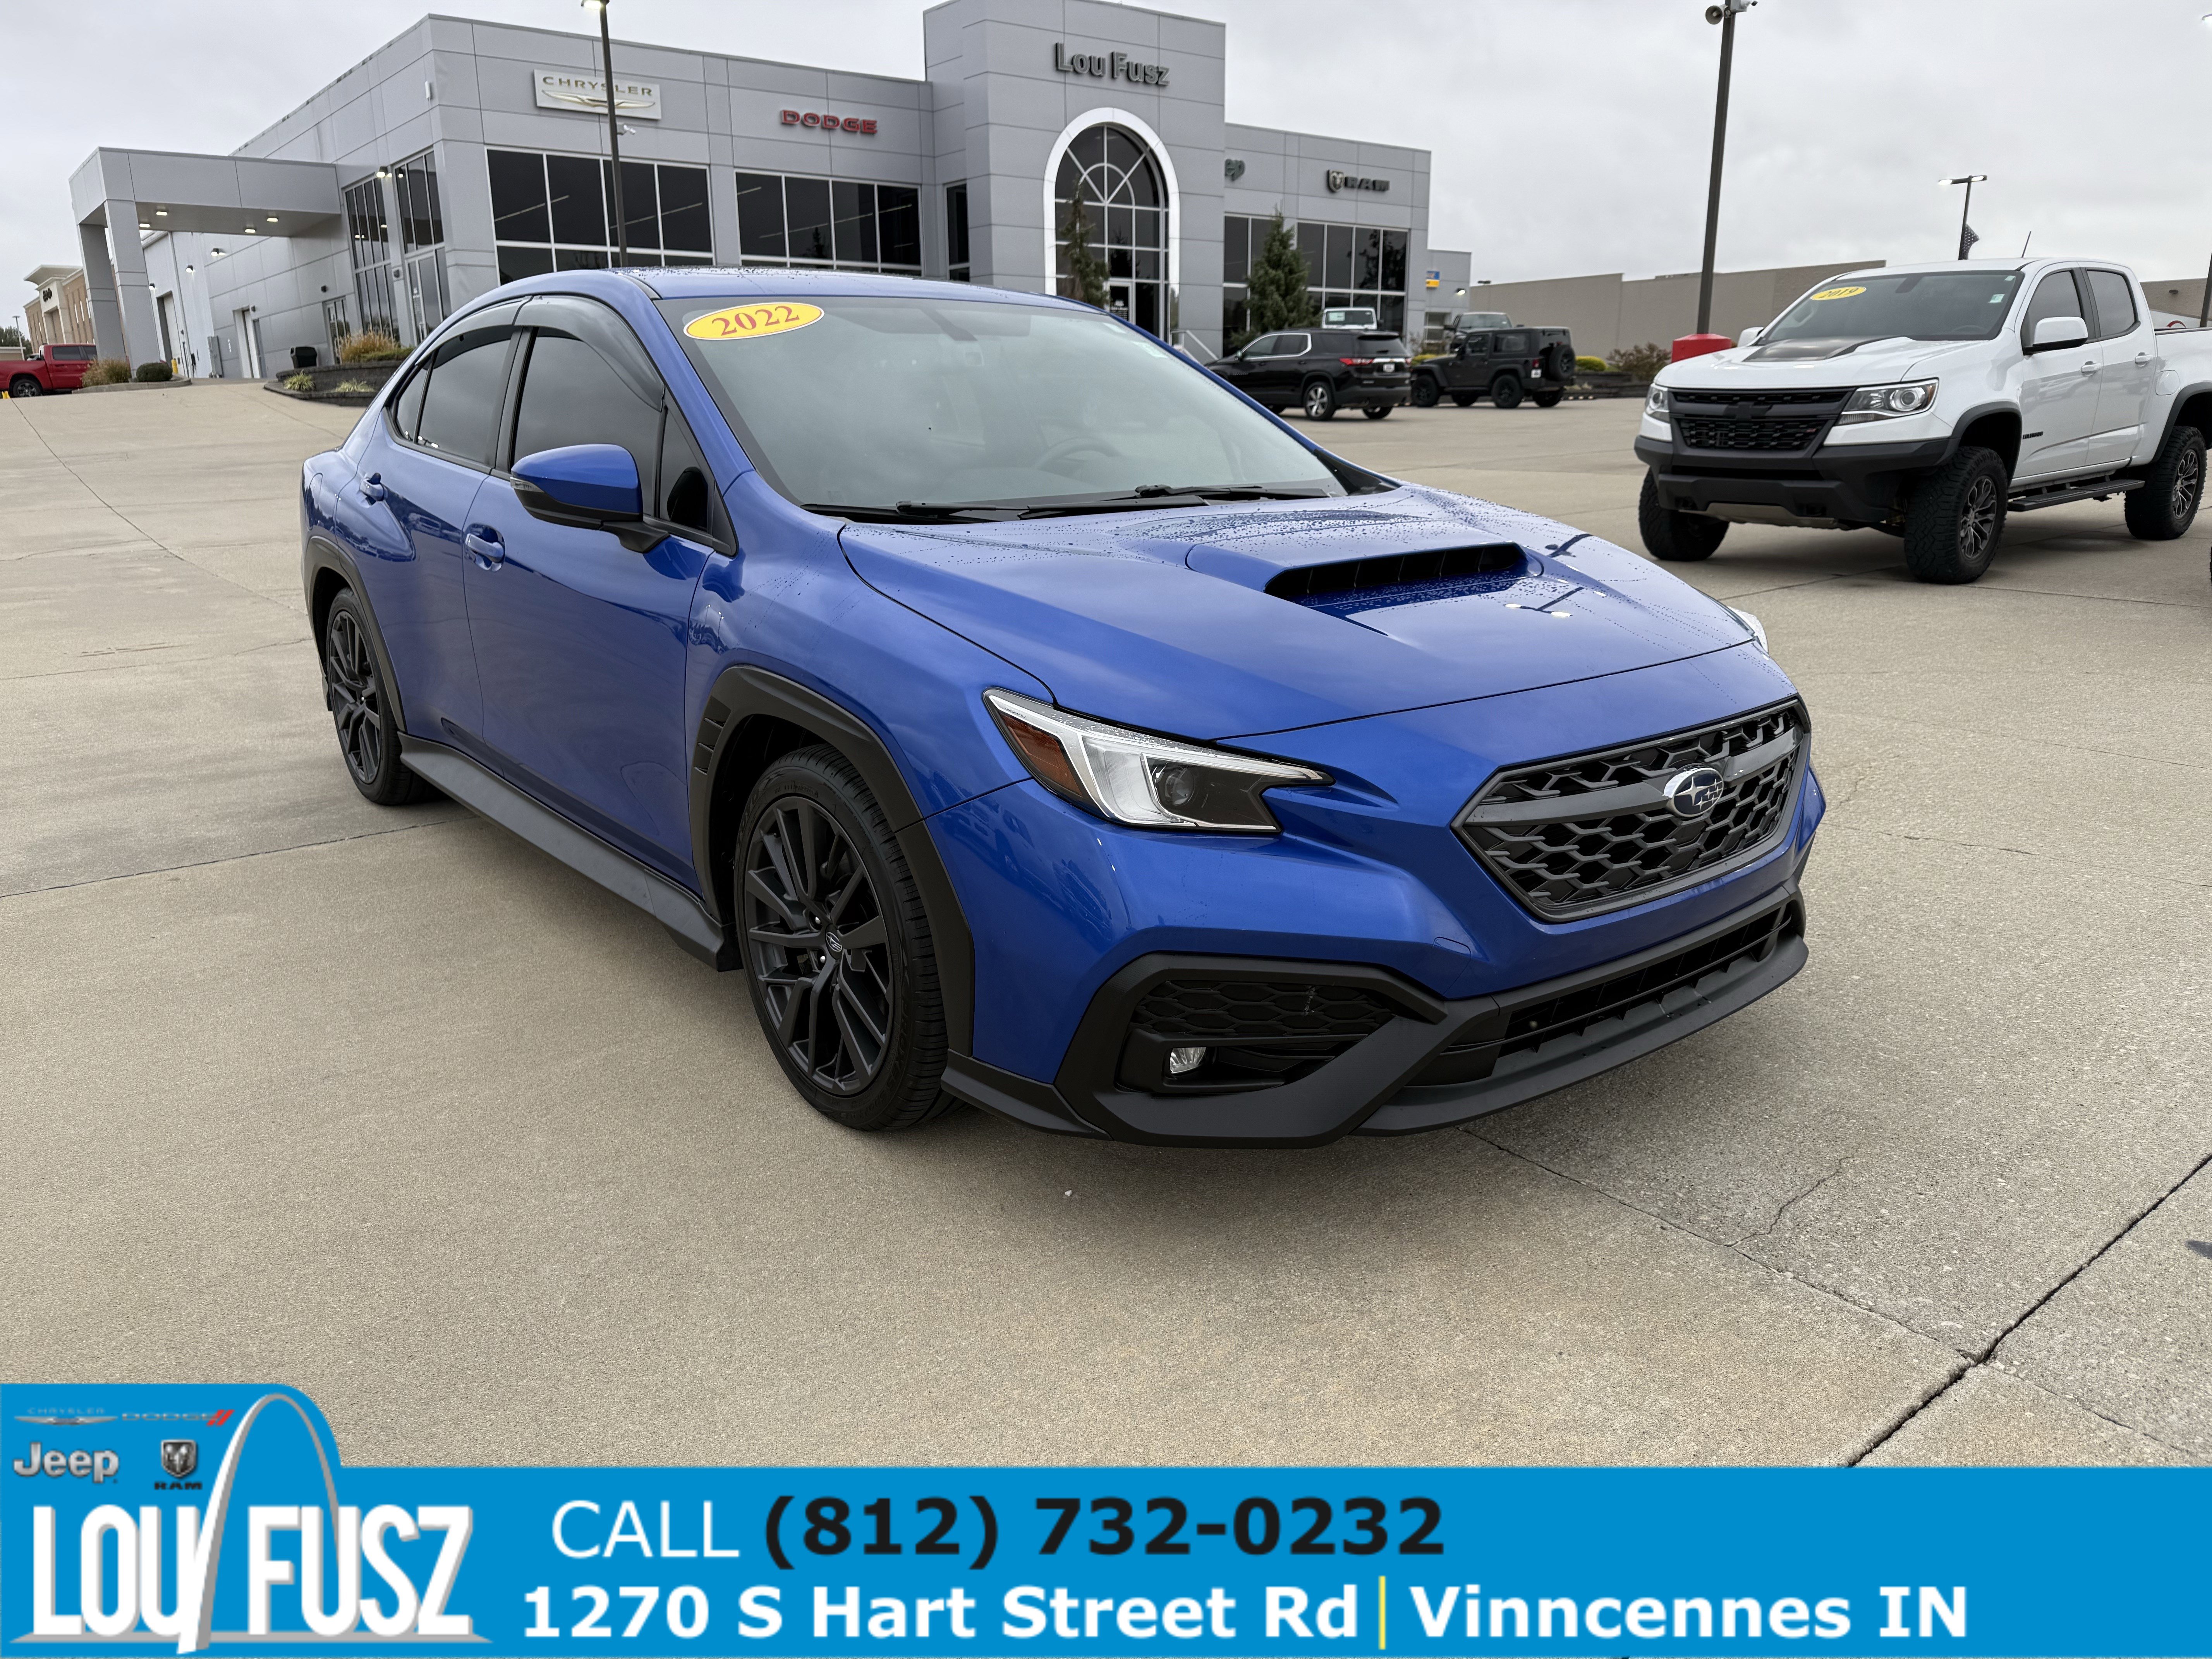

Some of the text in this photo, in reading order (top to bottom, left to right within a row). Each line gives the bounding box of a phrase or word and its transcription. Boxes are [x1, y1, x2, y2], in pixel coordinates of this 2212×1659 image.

[1055, 42, 1170, 86] Lou Fusz
[543, 76, 653, 96] CHRYSLER
[780, 110, 878, 134] DODGE
[1345, 176, 1390, 191] RAM
[1817, 287, 1859, 299] 2019
[711, 306, 800, 336] 2022
